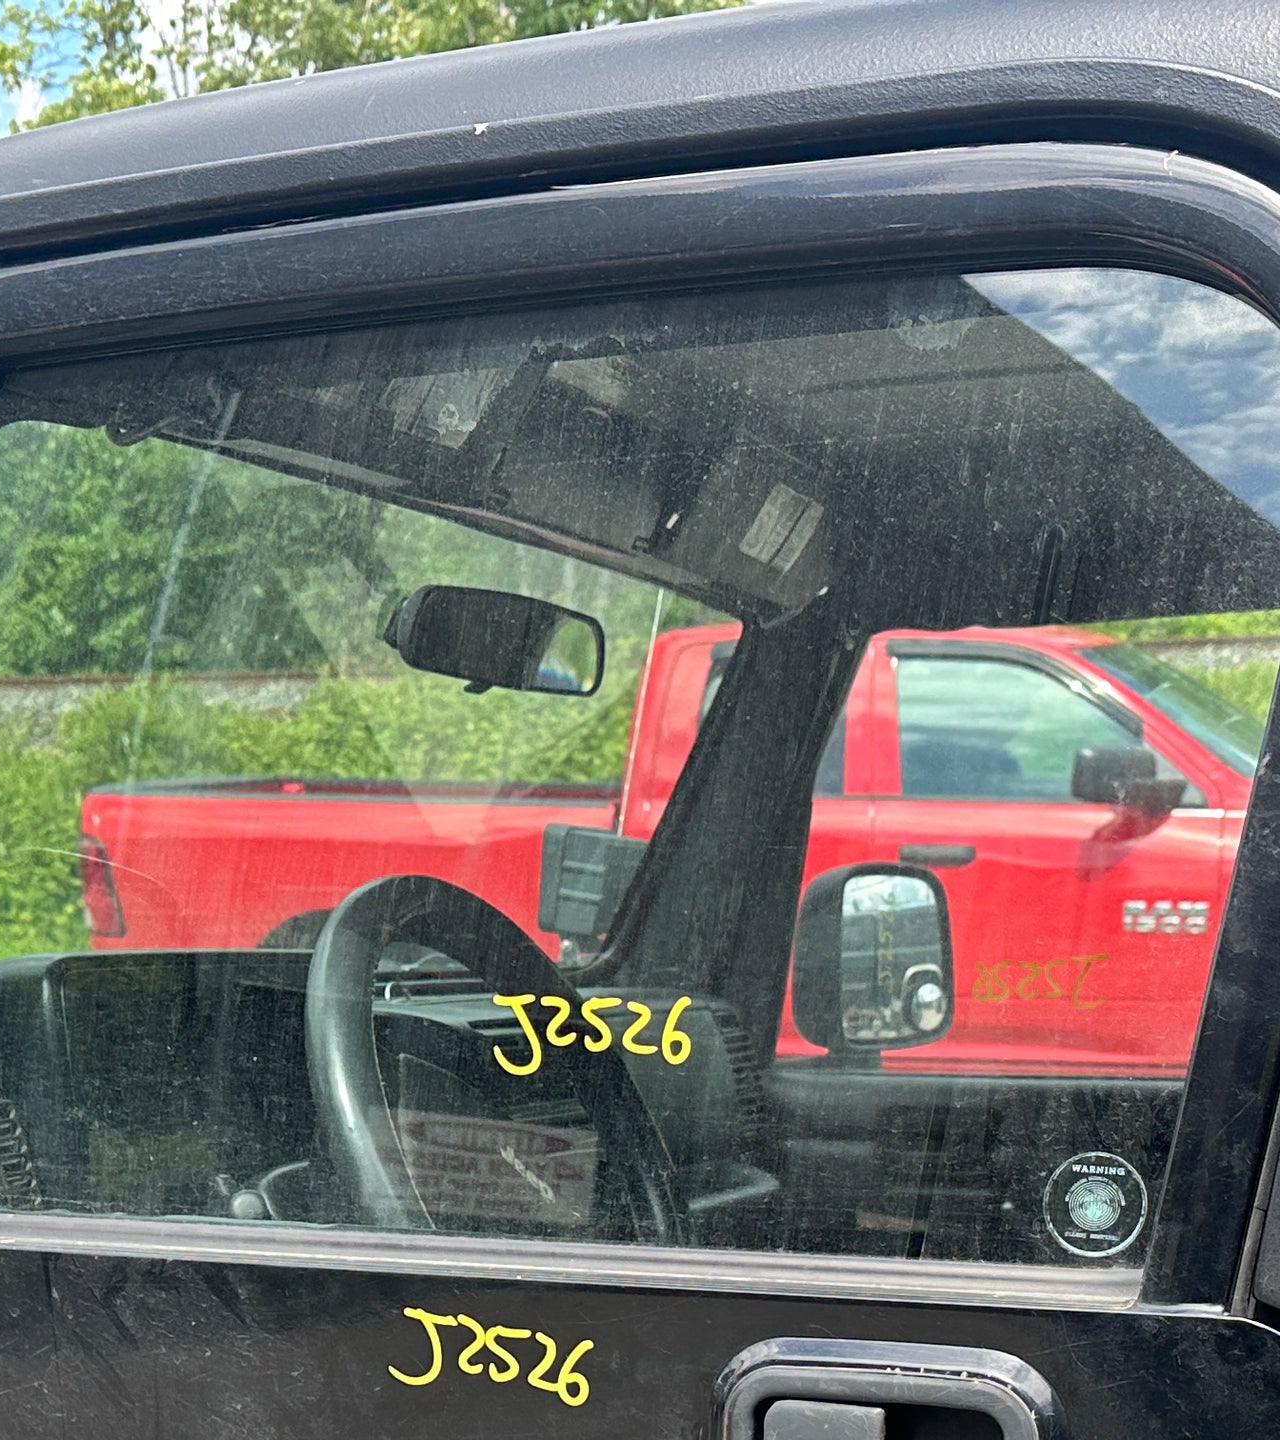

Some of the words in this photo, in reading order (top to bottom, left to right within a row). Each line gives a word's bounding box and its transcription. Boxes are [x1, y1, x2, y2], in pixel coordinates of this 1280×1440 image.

[492, 993, 693, 1076] J2526
[1071, 1164, 1126, 1176] WARNING
[387, 1306, 594, 1407] J2526
